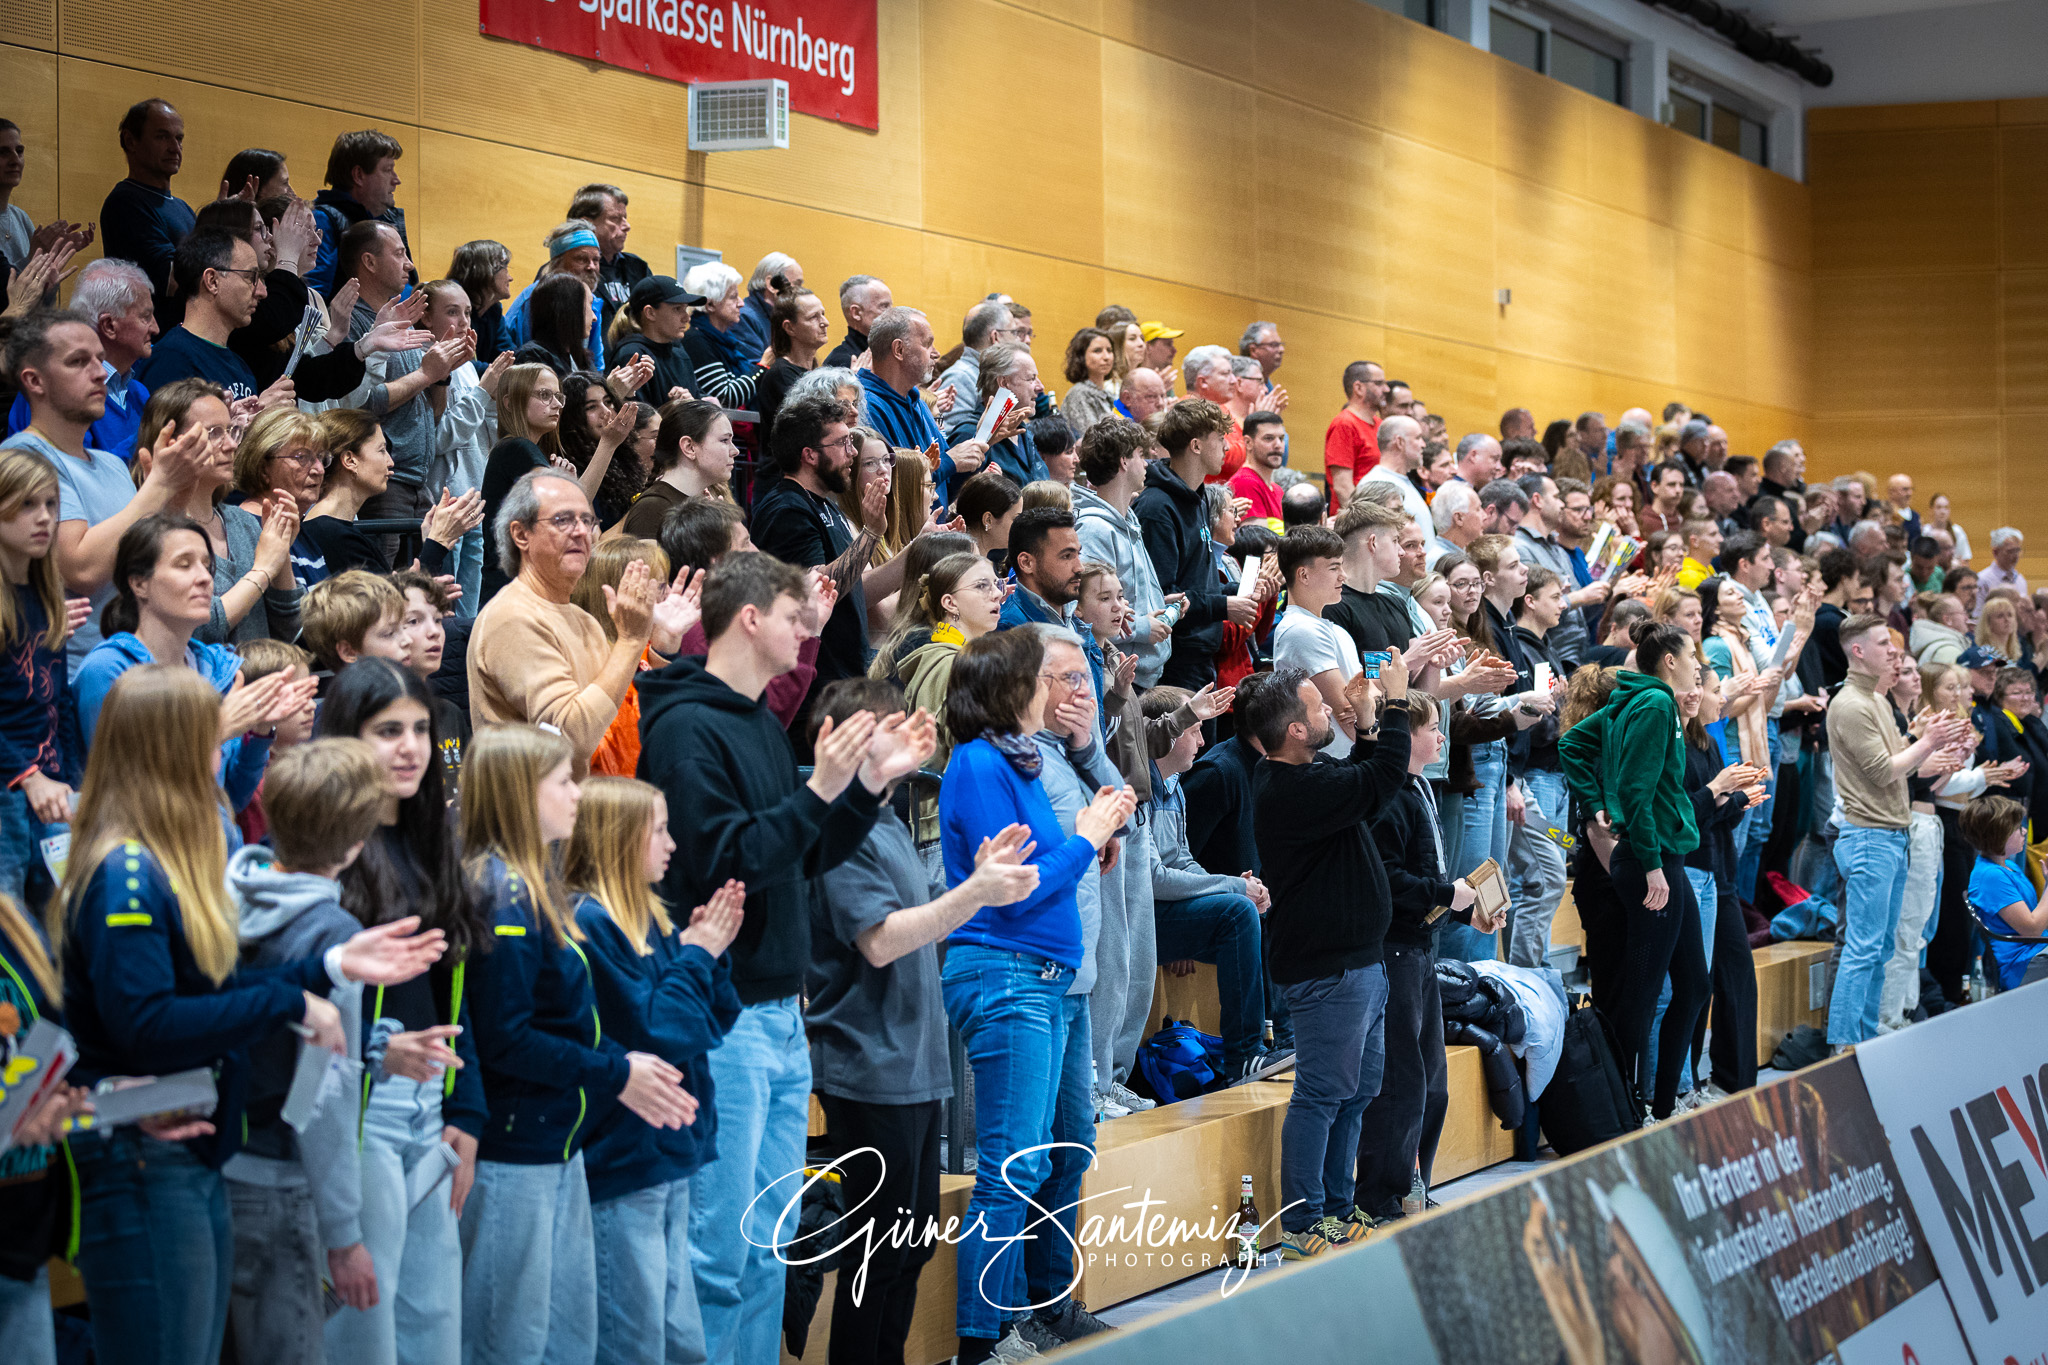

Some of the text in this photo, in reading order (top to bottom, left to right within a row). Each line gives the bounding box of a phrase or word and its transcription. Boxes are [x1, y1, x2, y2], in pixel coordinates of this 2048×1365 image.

[578, 0, 855, 96] parkasse Nürnberg
[1672, 1130, 1804, 1222] Ihr Partner in der
[1695, 1161, 1895, 1286] industriellen Instandhaltung,
[1770, 1206, 1915, 1321] Herstellerunabhängig!
